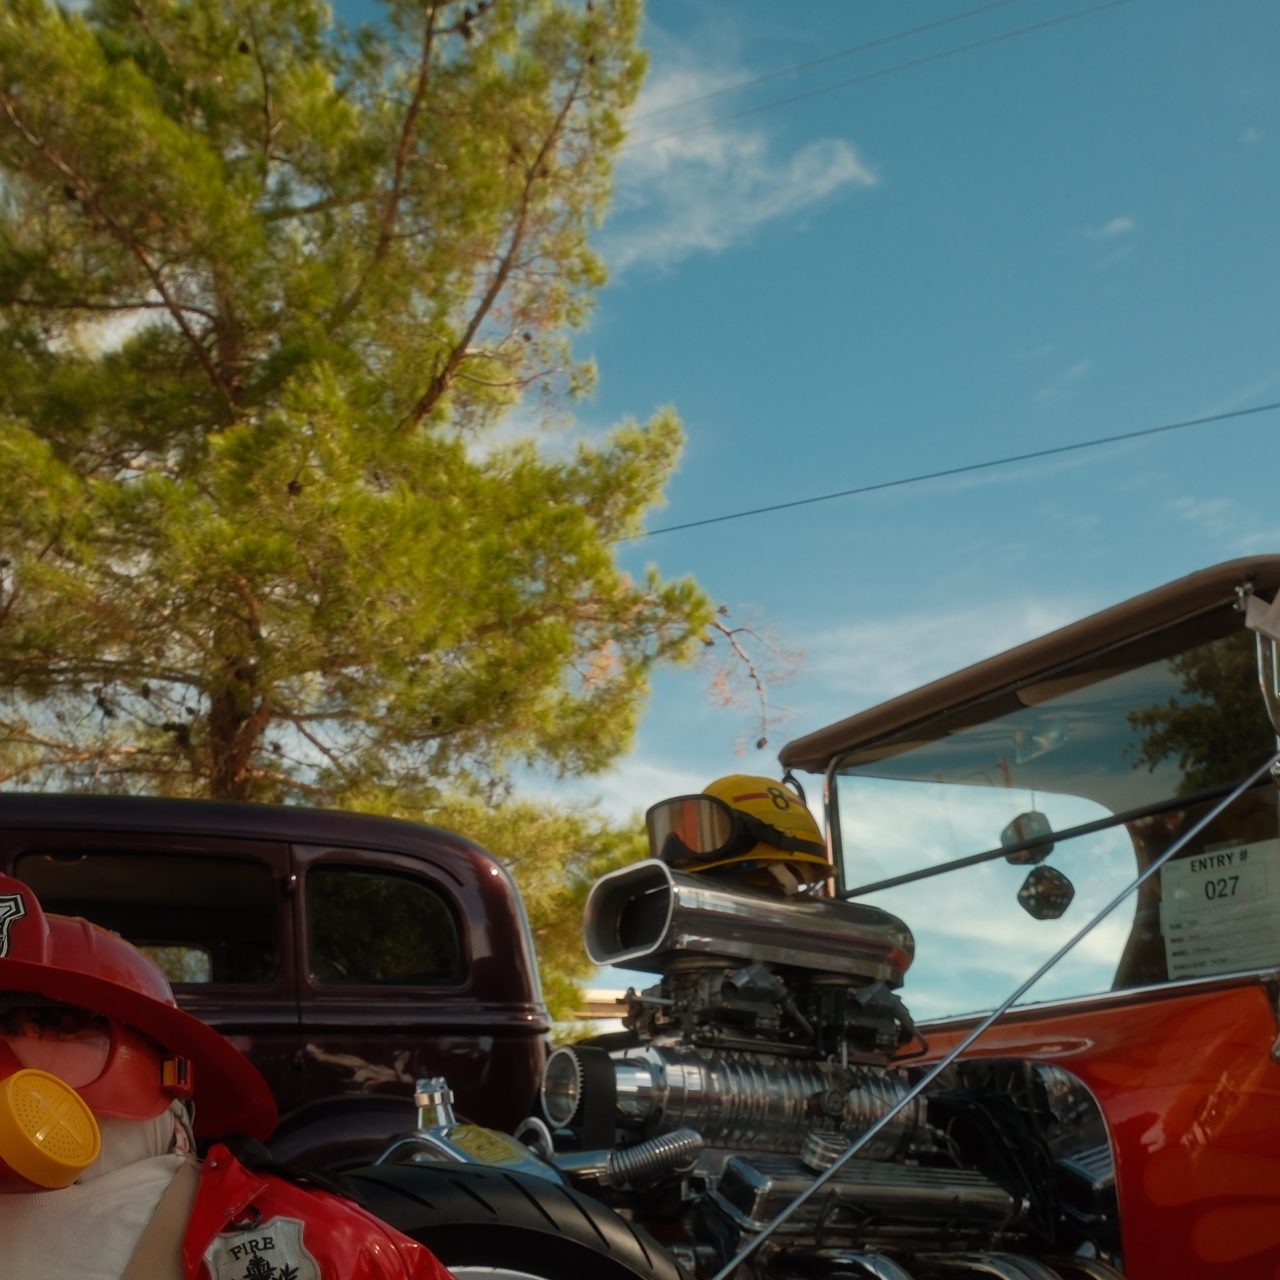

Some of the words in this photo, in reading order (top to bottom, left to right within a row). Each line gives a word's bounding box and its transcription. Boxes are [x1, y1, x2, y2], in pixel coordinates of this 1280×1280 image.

[768, 787, 789, 810] 8
[1190, 853, 1234, 873] ENTRY
[1239, 849, 1248, 862] #
[1204, 876, 1239, 900] 027
[228, 1237, 275, 1261] FIRE
